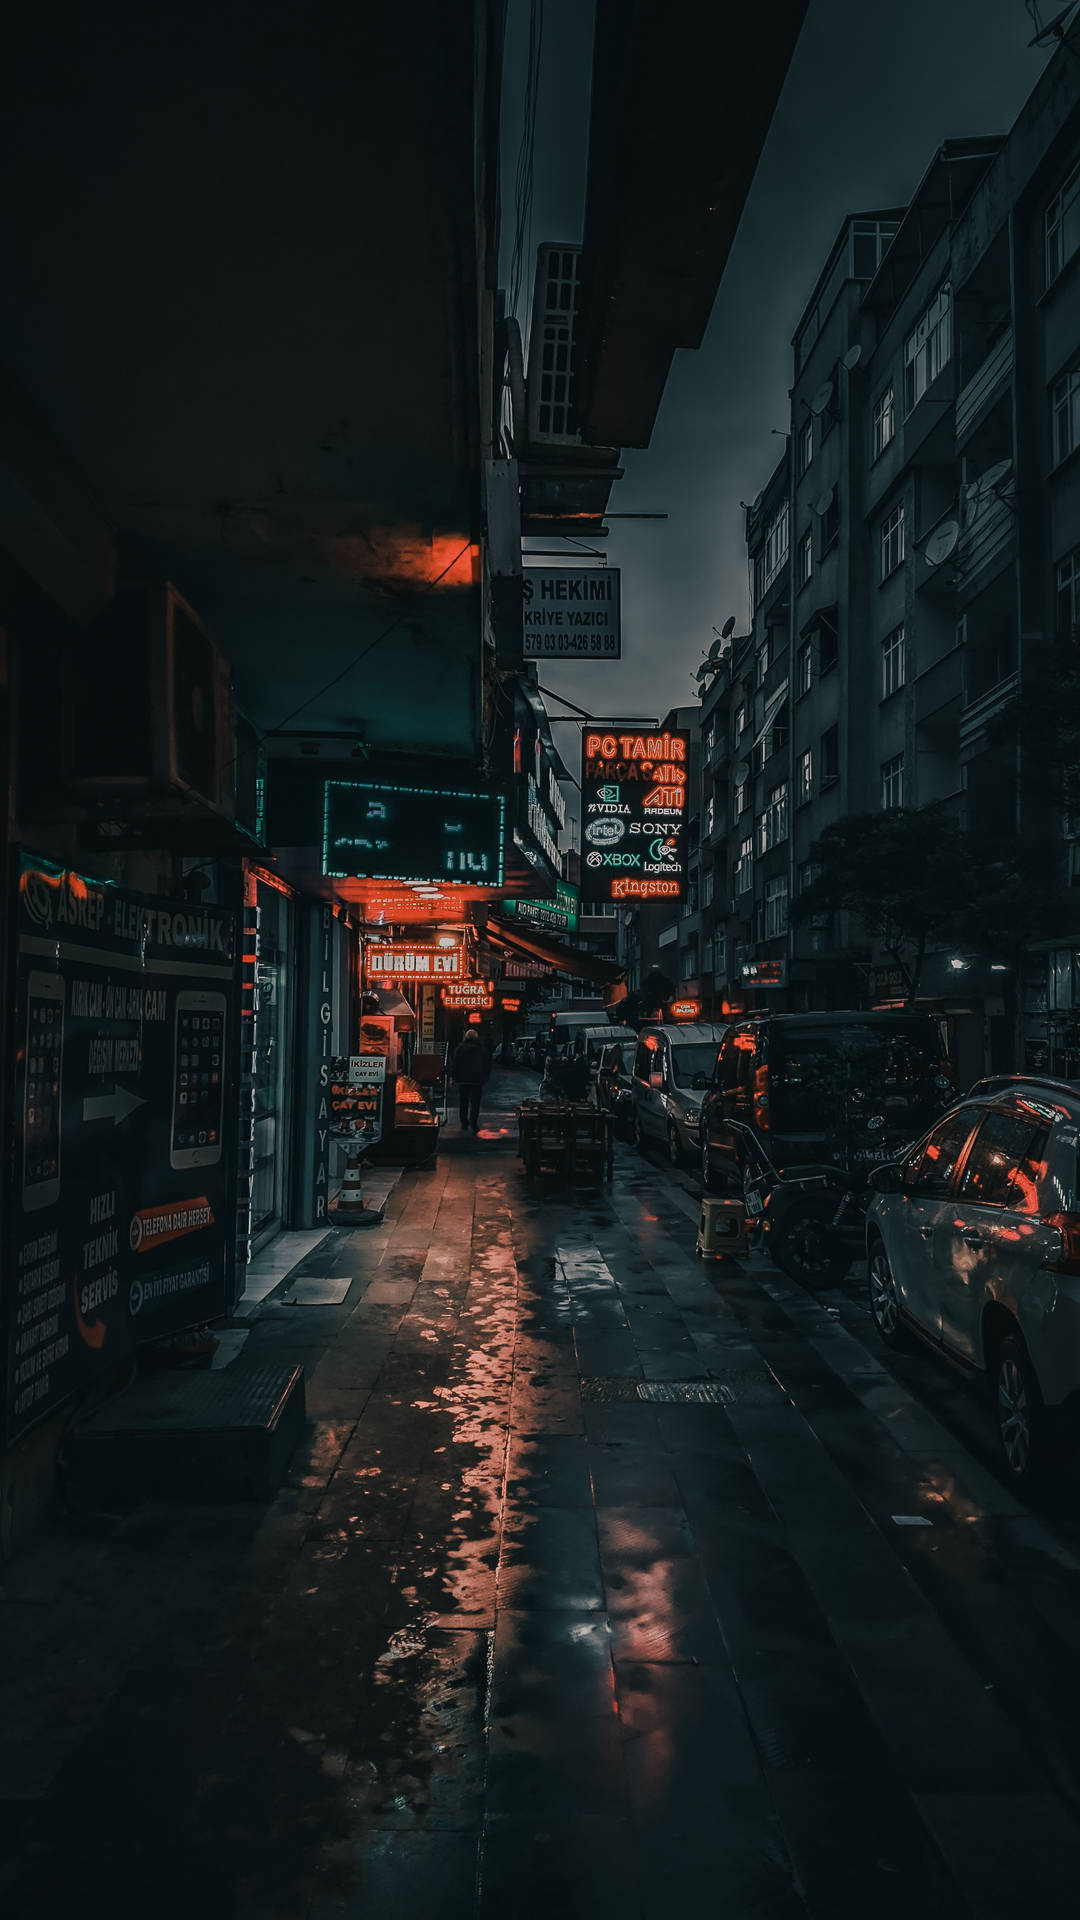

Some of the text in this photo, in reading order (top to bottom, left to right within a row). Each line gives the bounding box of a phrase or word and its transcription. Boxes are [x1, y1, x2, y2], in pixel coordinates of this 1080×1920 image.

[541, 575, 612, 601] HEKİMİ
[524, 608, 609, 626] KRİYE YAZICI
[544, 634, 556, 651] 03
[587, 732, 686, 761] PC TAMİR
[629, 822, 683, 835] SONY
[602, 852, 641, 867] XBOX
[643, 860, 682, 874] Logitech
[612, 877, 680, 898] Kingston
[114, 899, 225, 951] ELEKTRONİK
[371, 952, 458, 972] DÜRÜM EVİ
[448, 983, 485, 995] TUĞRA
[144, 989, 167, 1021] CAM
[445, 995, 488, 1005] ELEKTRİK
[89, 1190, 116, 1225] HIZLI
[142, 1212, 173, 1237] TELEFONA
[172, 1208, 188, 1231] DAİR
[83, 1225, 119, 1271] TEKNİK
[80, 1265, 119, 1315] SERVİS
